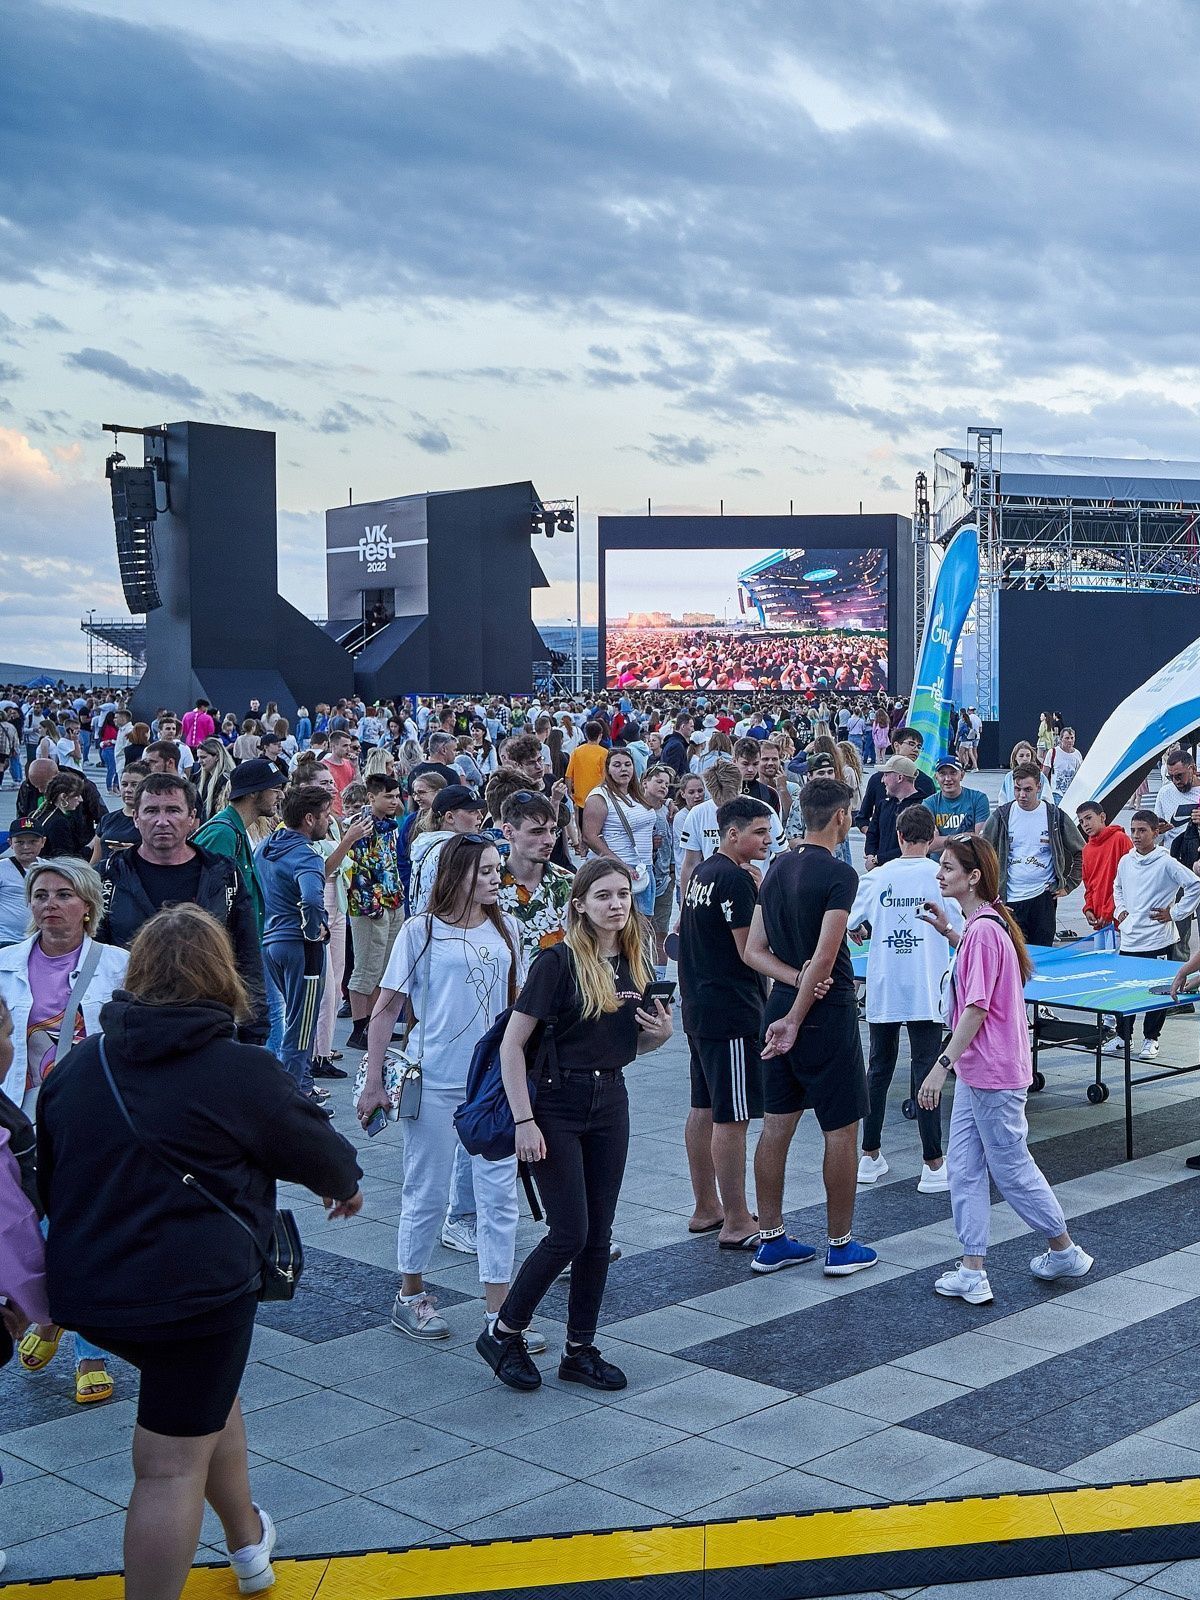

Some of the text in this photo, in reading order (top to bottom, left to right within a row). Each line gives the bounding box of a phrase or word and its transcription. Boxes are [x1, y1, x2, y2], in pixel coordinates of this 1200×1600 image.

[364, 523, 388, 543] VK
[358, 536, 397, 562] fest
[366, 561, 387, 573] 2022
[935, 813, 974, 830] ADIDAS
[893, 928, 913, 939] VK
[887, 935, 919, 949] fest
